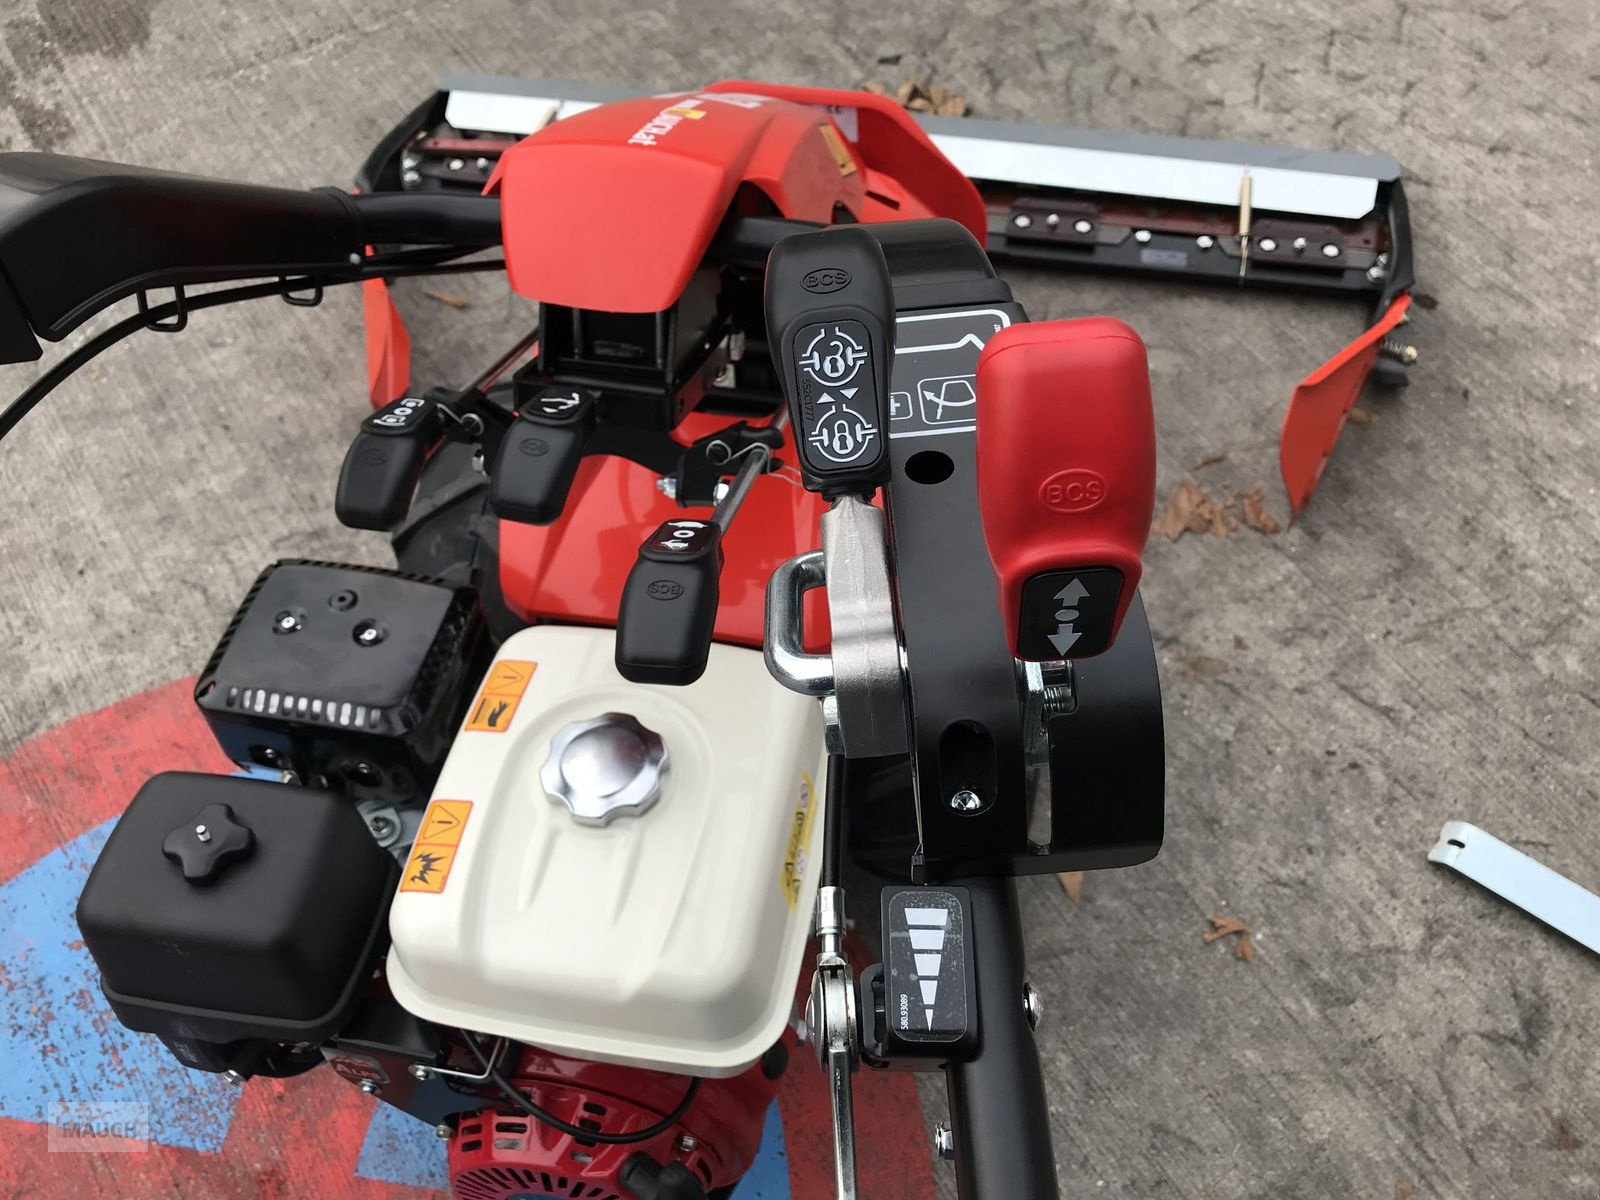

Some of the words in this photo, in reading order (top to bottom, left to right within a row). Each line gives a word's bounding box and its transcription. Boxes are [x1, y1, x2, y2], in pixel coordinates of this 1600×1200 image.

[804, 271, 848, 289] BCS
[1046, 480, 1101, 504] BCS
[900, 993, 909, 1030] 580.93089
